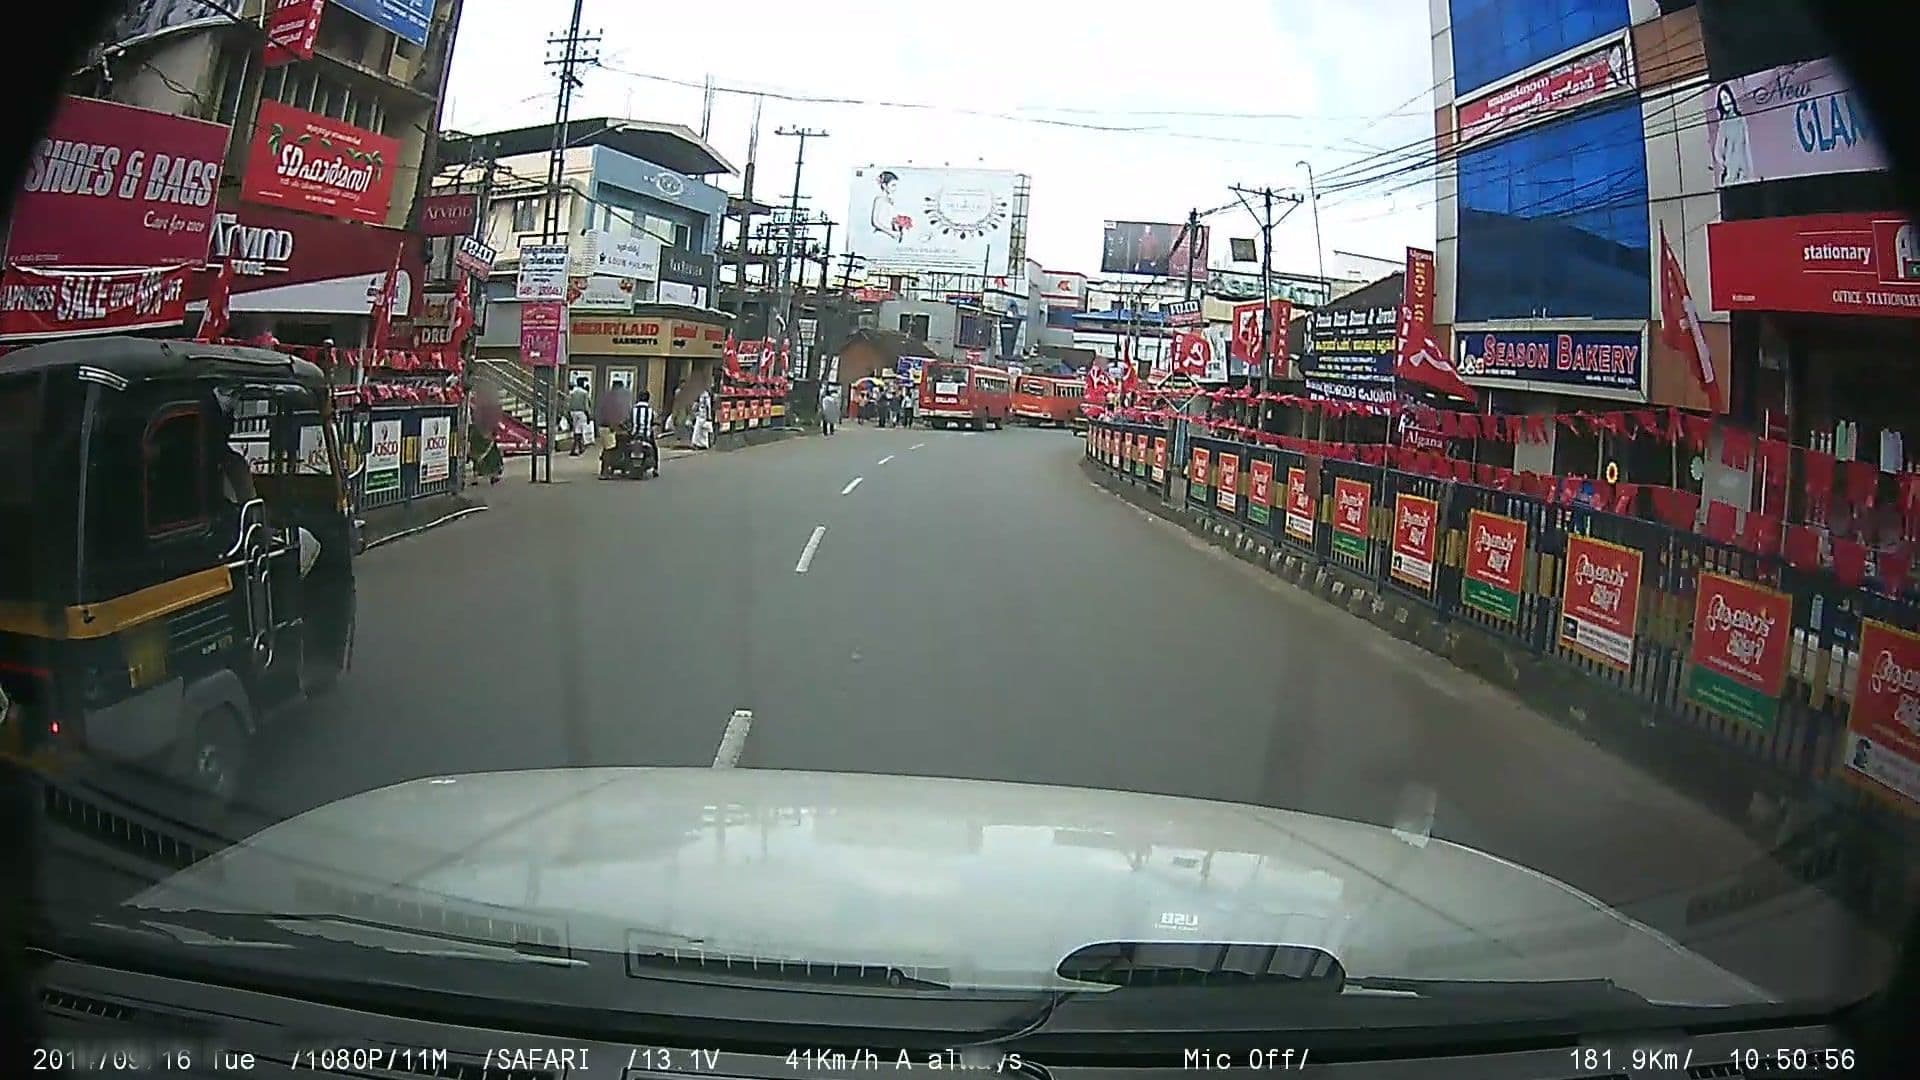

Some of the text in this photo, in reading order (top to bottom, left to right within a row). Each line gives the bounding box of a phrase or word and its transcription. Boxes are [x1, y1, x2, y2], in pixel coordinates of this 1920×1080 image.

[24, 138, 121, 197] SHOES
[118, 150, 145, 199] &
[143, 153, 218, 208] BAGS
[1803, 242, 1871, 265] stationary
[230, 258, 267, 276] TORE
[57, 276, 113, 320] SALE
[164, 278, 184, 302] OFF
[1832, 290, 1862, 304] OFFICE
[1483, 333, 1639, 375] SEASON BAKERY
[372, 440, 399, 457] JOSCO
[423, 437, 448, 452] JOSCO
